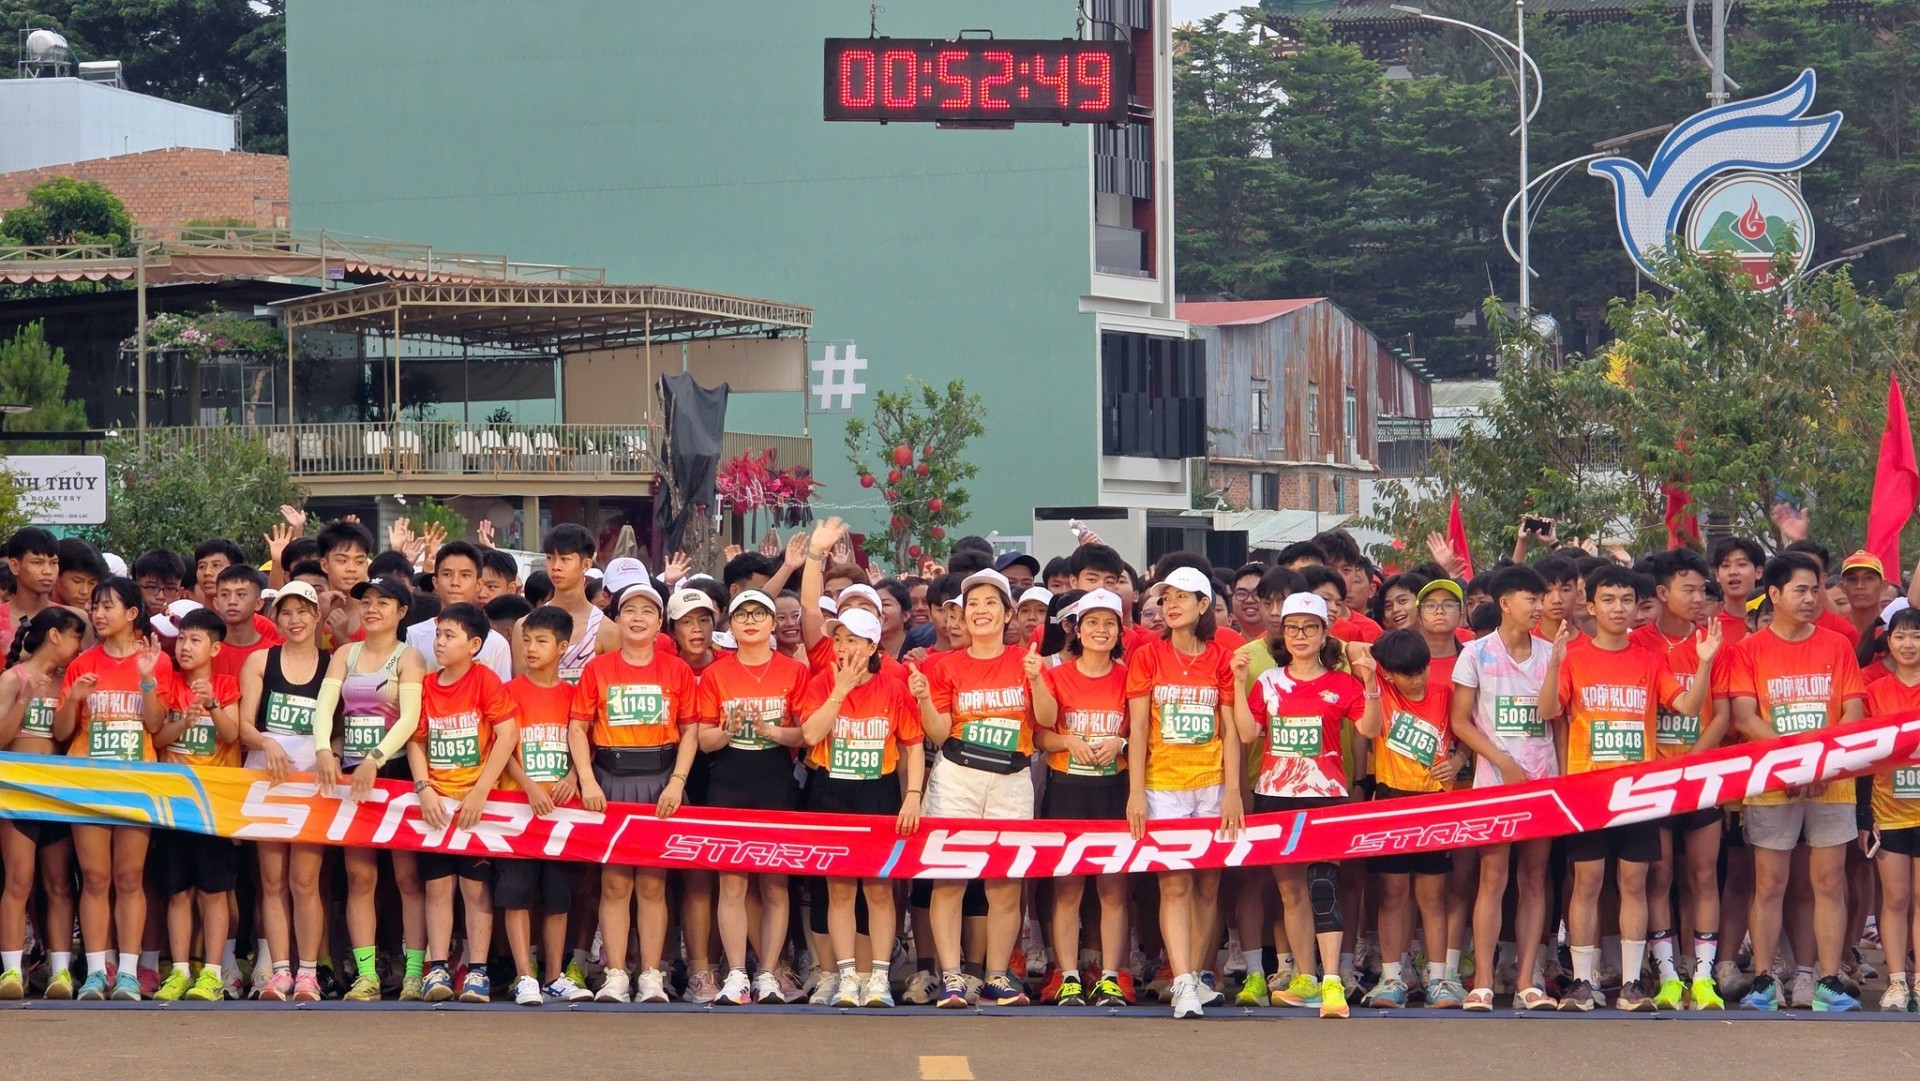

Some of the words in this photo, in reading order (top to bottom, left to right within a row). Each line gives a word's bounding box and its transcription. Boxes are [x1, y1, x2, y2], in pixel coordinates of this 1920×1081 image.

[839, 50, 1111, 109] 00:52:49
[14, 477, 39, 490] NH
[46, 472, 97, 490] THỦY
[30, 708, 54, 725] 510
[1165, 715, 1211, 733] 51206
[1776, 713, 1824, 733] 911997
[93, 732, 139, 749] 51262
[344, 727, 380, 745] 50961
[967, 724, 1013, 747] 51147
[1272, 727, 1319, 745] 50923
[1395, 723, 1436, 754] 51155
[1594, 732, 1642, 749] 50848
[430, 738, 476, 757] 50852
[526, 752, 569, 770] 50872
[834, 749, 879, 768] 51298
[231, 780, 606, 857] START
[1344, 812, 1532, 854] START
[659, 834, 850, 870] START
[912, 824, 1282, 879] START
